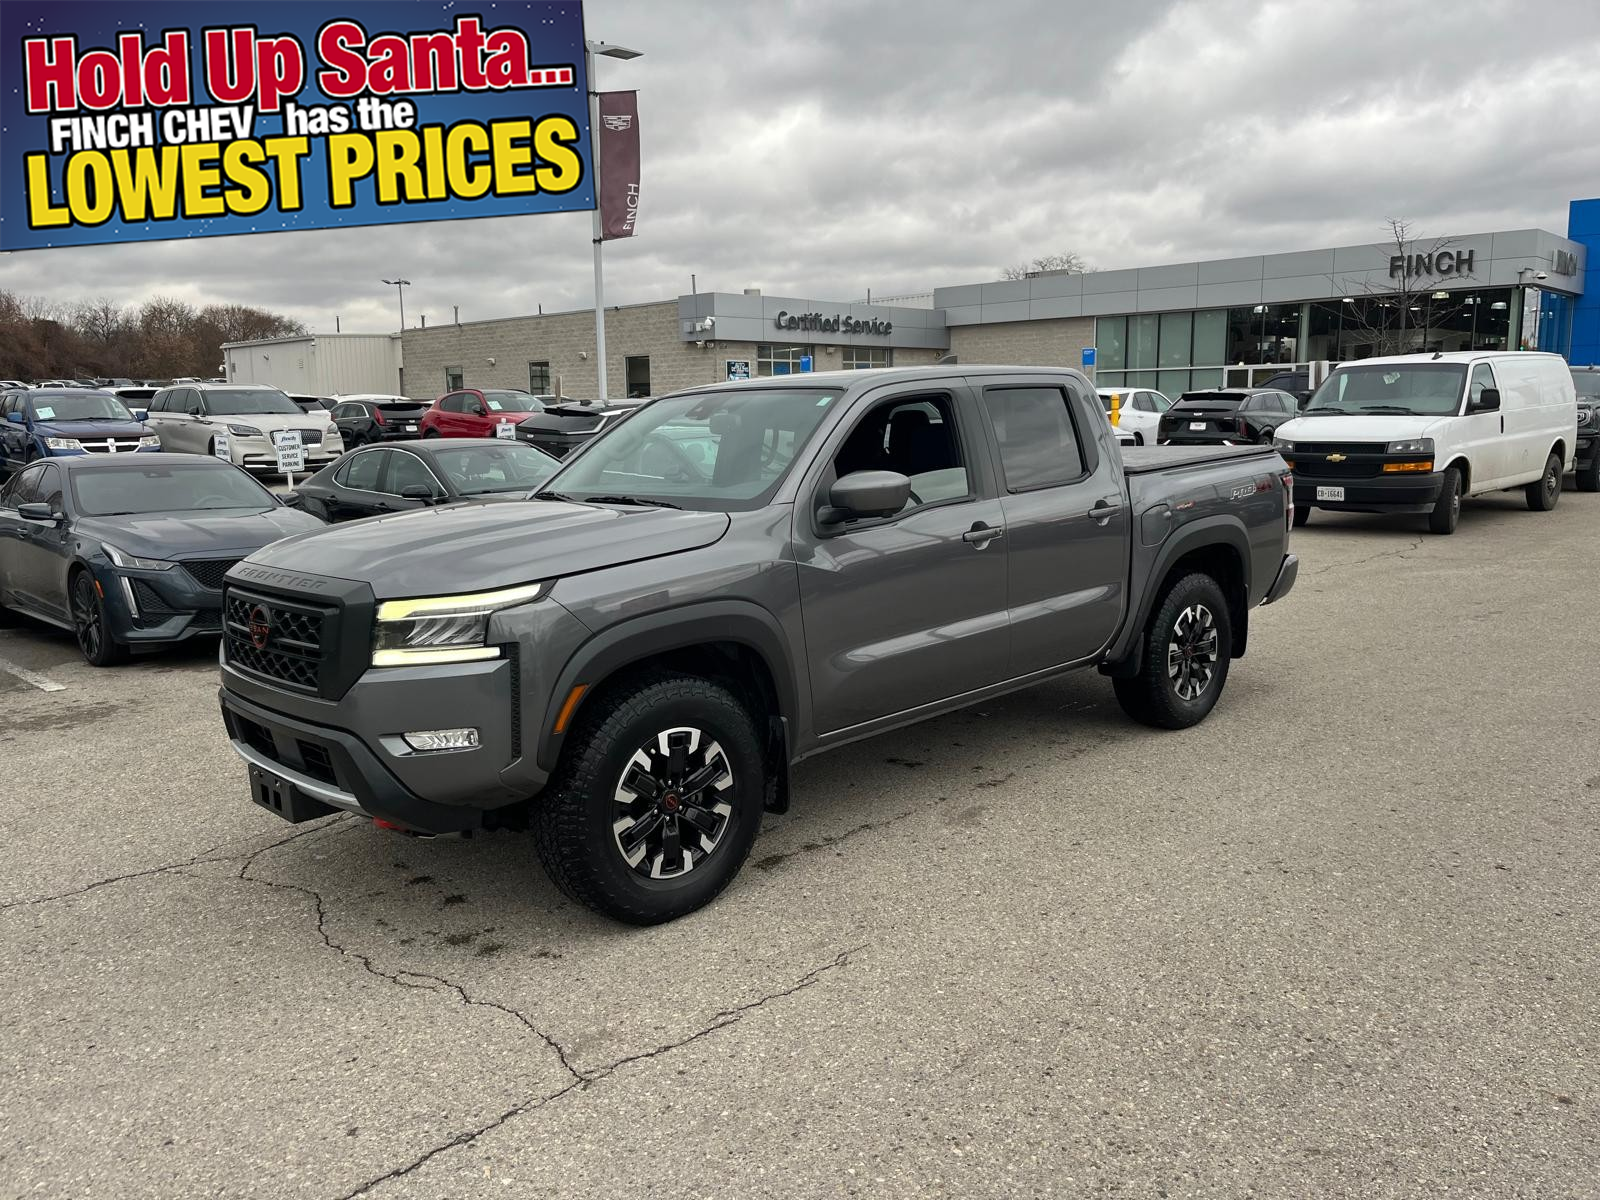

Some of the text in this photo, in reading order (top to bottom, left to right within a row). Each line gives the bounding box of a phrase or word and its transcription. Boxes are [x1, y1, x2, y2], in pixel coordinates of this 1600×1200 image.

[622, 183, 639, 230] FINCH
[1389, 250, 1474, 278] FINCH
[775, 311, 892, 335] Certified Service
[278, 444, 300, 452] CUSTOMER
[282, 460, 299, 468] PARKING
[238, 567, 327, 589] FRONTIER
